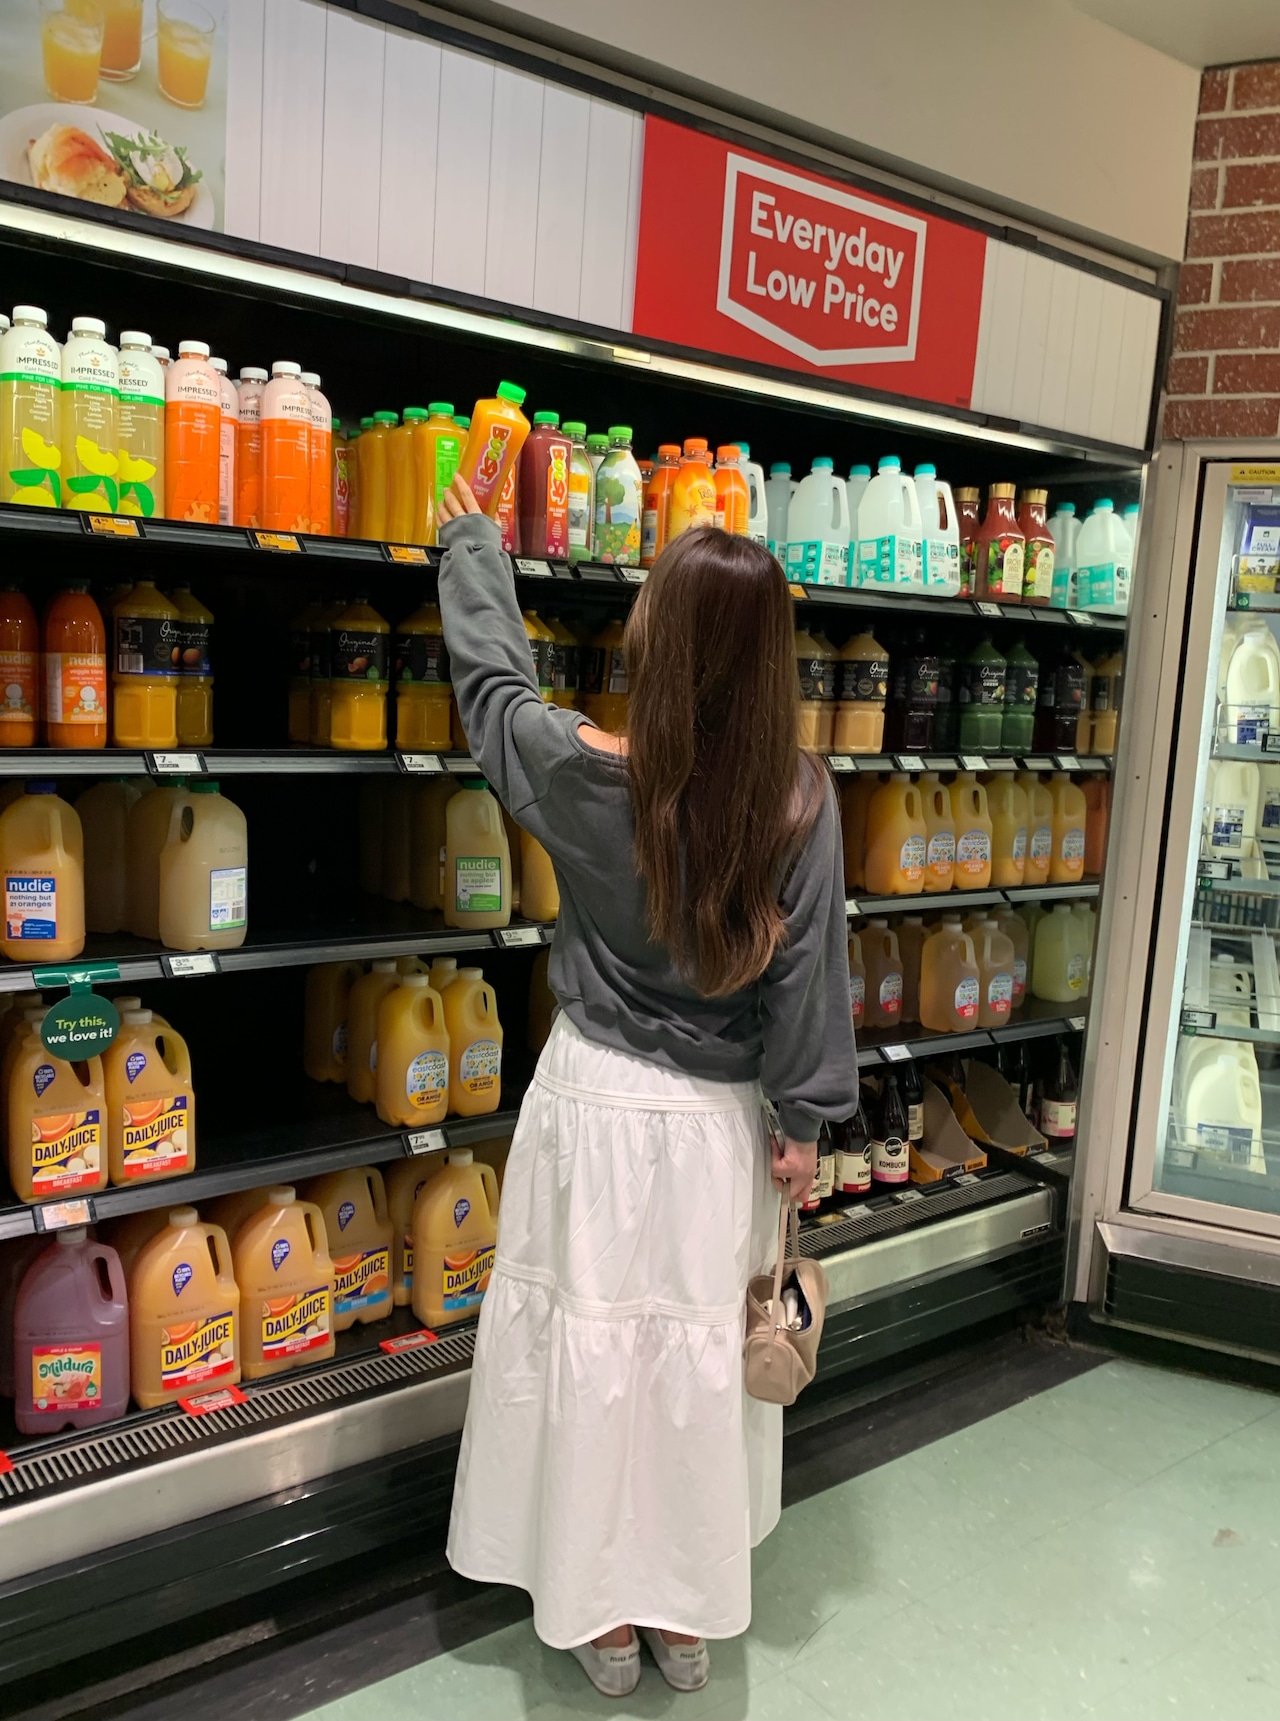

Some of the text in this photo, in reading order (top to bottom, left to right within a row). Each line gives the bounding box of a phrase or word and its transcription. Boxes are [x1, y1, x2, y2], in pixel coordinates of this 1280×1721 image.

[750, 190, 904, 288] Everyday
[746, 251, 898, 332] Low Price
[16, 357, 58, 369] IMPRESSED
[71, 367, 115, 378] IMPRESSED
[119, 379, 148, 387] RESSED
[177, 386, 217, 397] IMPRESSED
[479, 425, 511, 484] BOOST
[550, 447, 567, 504] BOOST
[339, 632, 378, 648] Original
[69, 654, 103, 666] nudie
[460, 859, 496, 870] nudie
[9, 879, 52, 891] nudie
[56, 1016, 106, 1031] Try this,
[47, 1028, 113, 1044] we love it!
[469, 1080, 493, 1089] ORANGE
[416, 1093, 441, 1103] ORANGE
[126, 1114, 184, 1145] DAILY JUICE
[35, 1129, 96, 1162] DAILY JUICE
[142, 1159, 171, 1170] BREAKFAST
[879, 1160, 906, 1168] KOMBUCHA
[52, 1176, 83, 1188] BREAKFAST
[359, 1256, 386, 1282] JUICE
[447, 1256, 495, 1289] DAILY JUIC
[266, 1296, 326, 1336] DAILY JUICE
[165, 1322, 230, 1366] DAILY JUICE
[39, 1357, 94, 1378] Mildura
